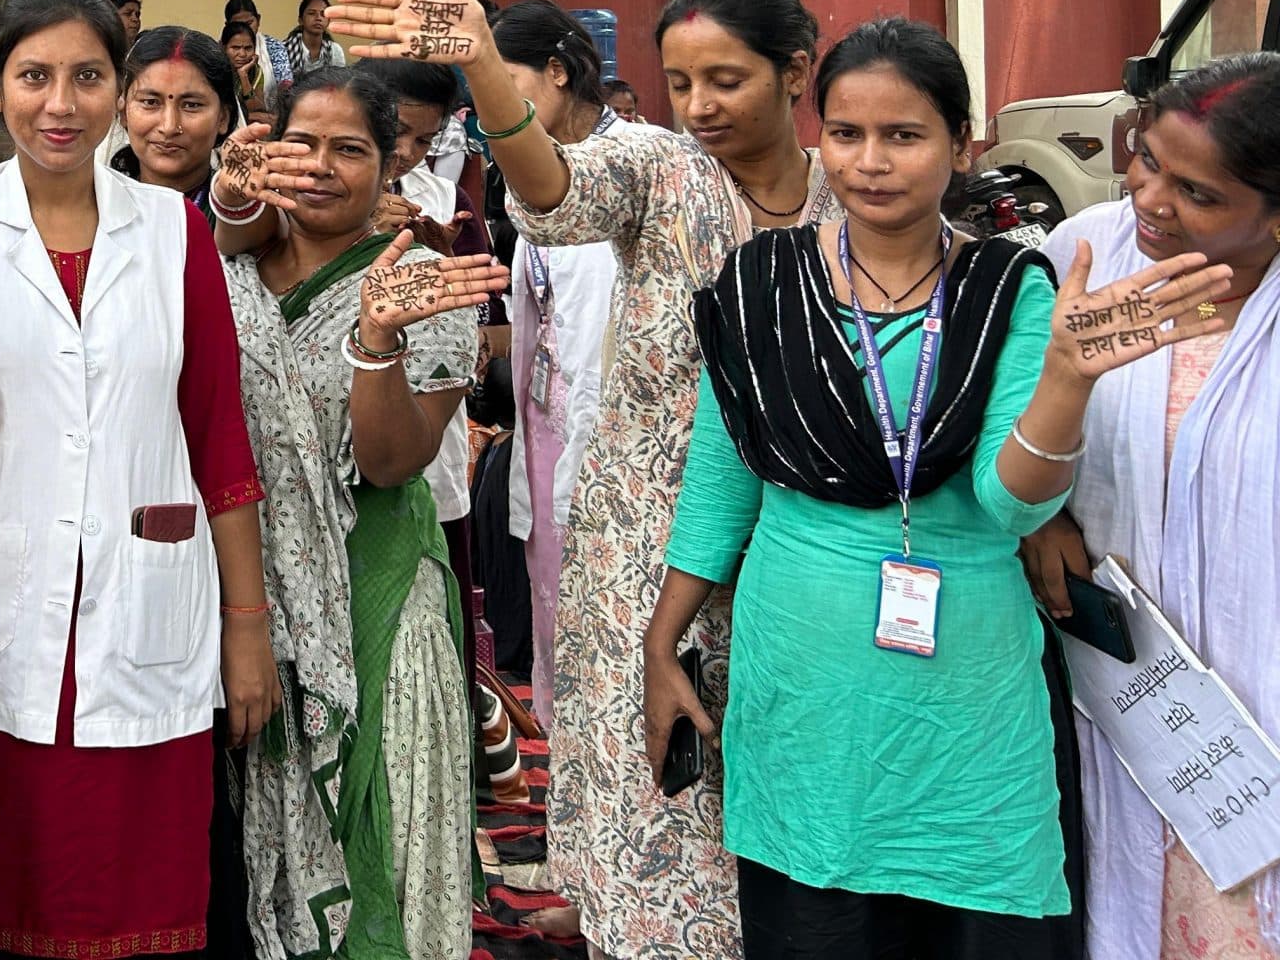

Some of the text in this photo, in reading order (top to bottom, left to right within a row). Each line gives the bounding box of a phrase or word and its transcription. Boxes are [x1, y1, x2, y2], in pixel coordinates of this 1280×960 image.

[368, 263, 413, 290] NHM
[1065, 305, 1117, 332] मंगल
[922, 334, 933, 352] Bihar
[1077, 325, 1158, 360] हाय हाय
[882, 415, 893, 441] Health
[1166, 735, 1244, 794] कैडर निर्माण
